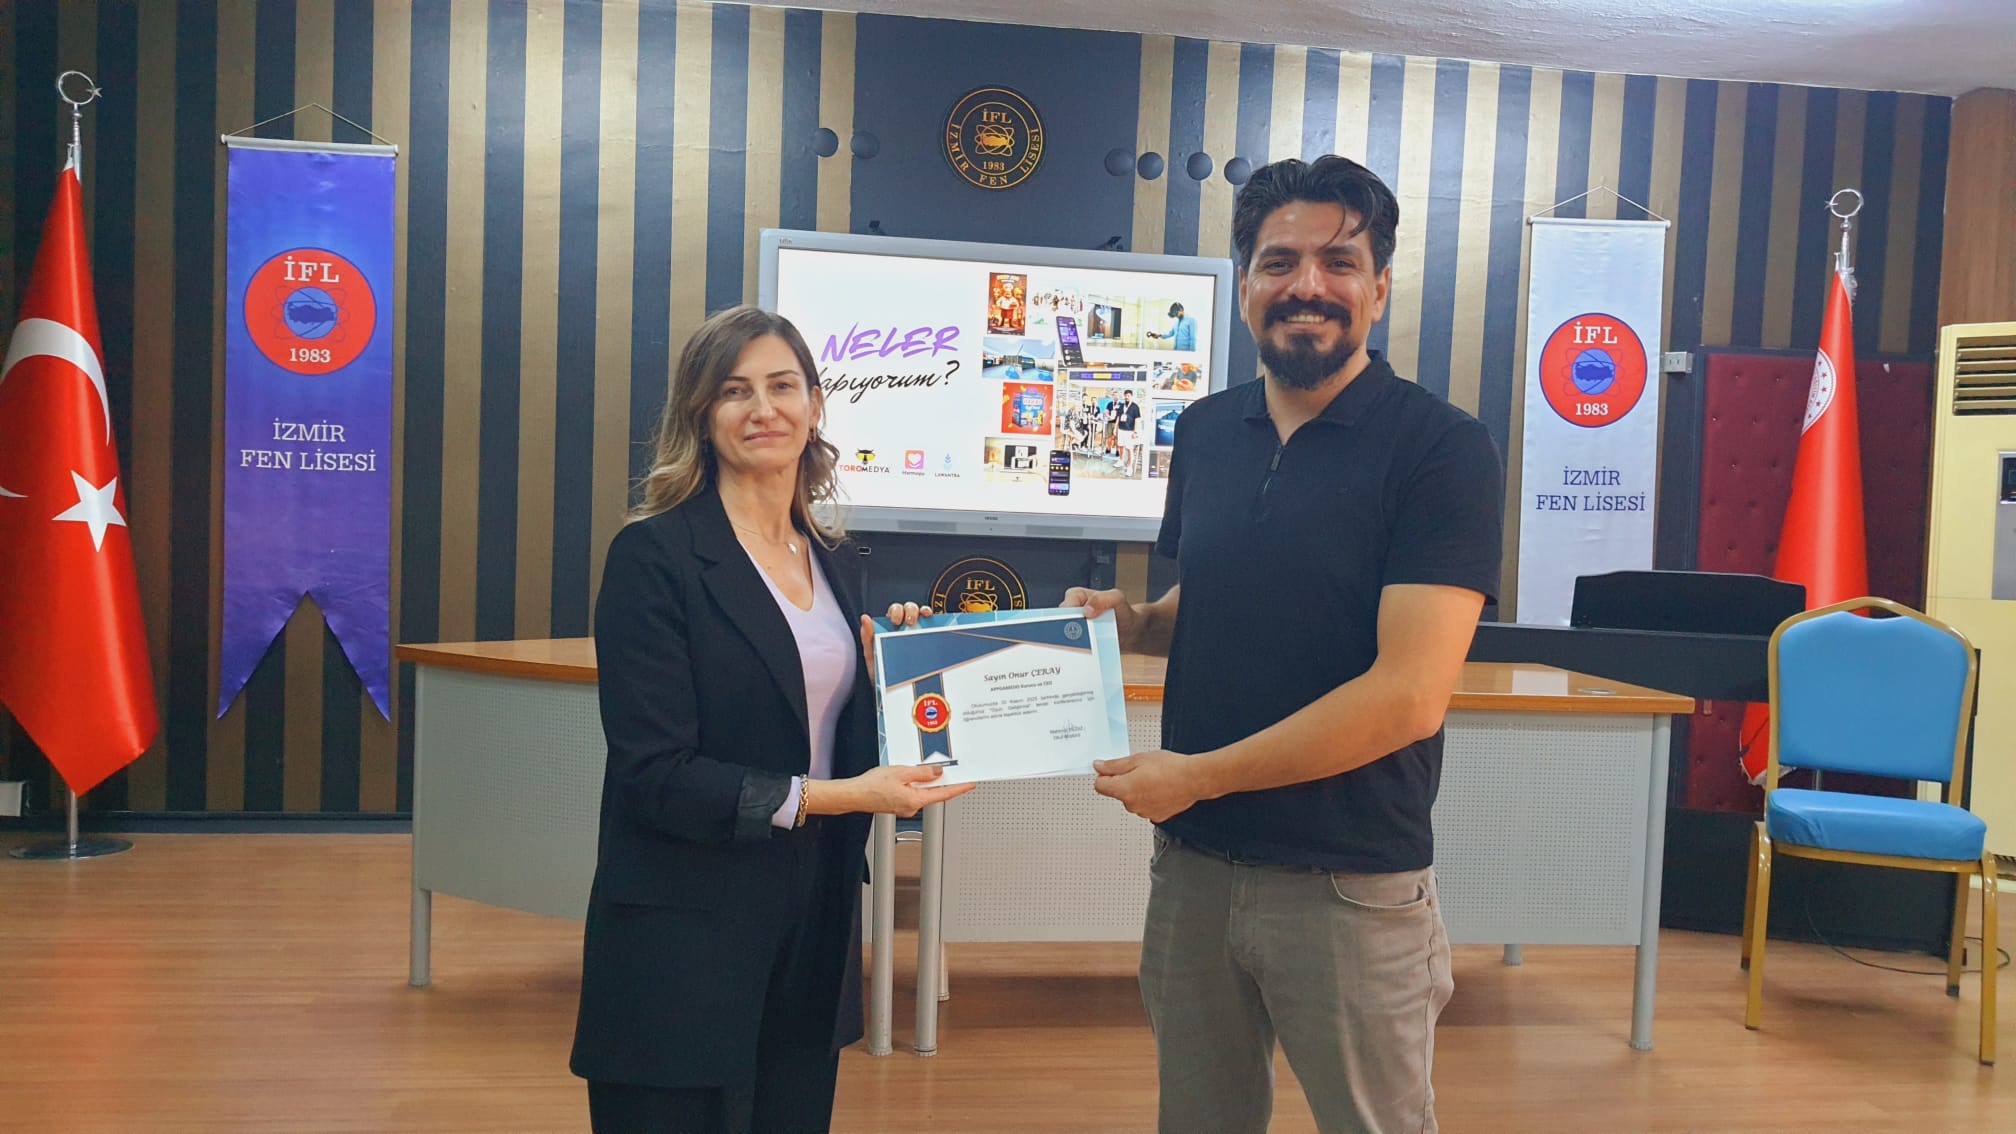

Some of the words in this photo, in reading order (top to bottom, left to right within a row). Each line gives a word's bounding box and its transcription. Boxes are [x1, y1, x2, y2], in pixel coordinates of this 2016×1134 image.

[982, 108, 1012, 124] İFL
[983, 161, 1006, 171] 1983
[979, 175, 1008, 186] FEN
[284, 256, 340, 283] İFL
[1572, 321, 1618, 344] İFL
[821, 322, 960, 362] NELER
[289, 348, 331, 363] 1983
[1575, 403, 1609, 416] 1983
[272, 417, 346, 442] İZMİR
[240, 449, 293, 469] FEN
[299, 448, 377, 472] LİSESİ
[1562, 466, 1621, 486] İZMİR
[1536, 495, 1578, 511] FEN
[1583, 491, 1646, 511] LİSESİ
[965, 577, 996, 591] İFL
[1008, 671, 1029, 679] Onur
